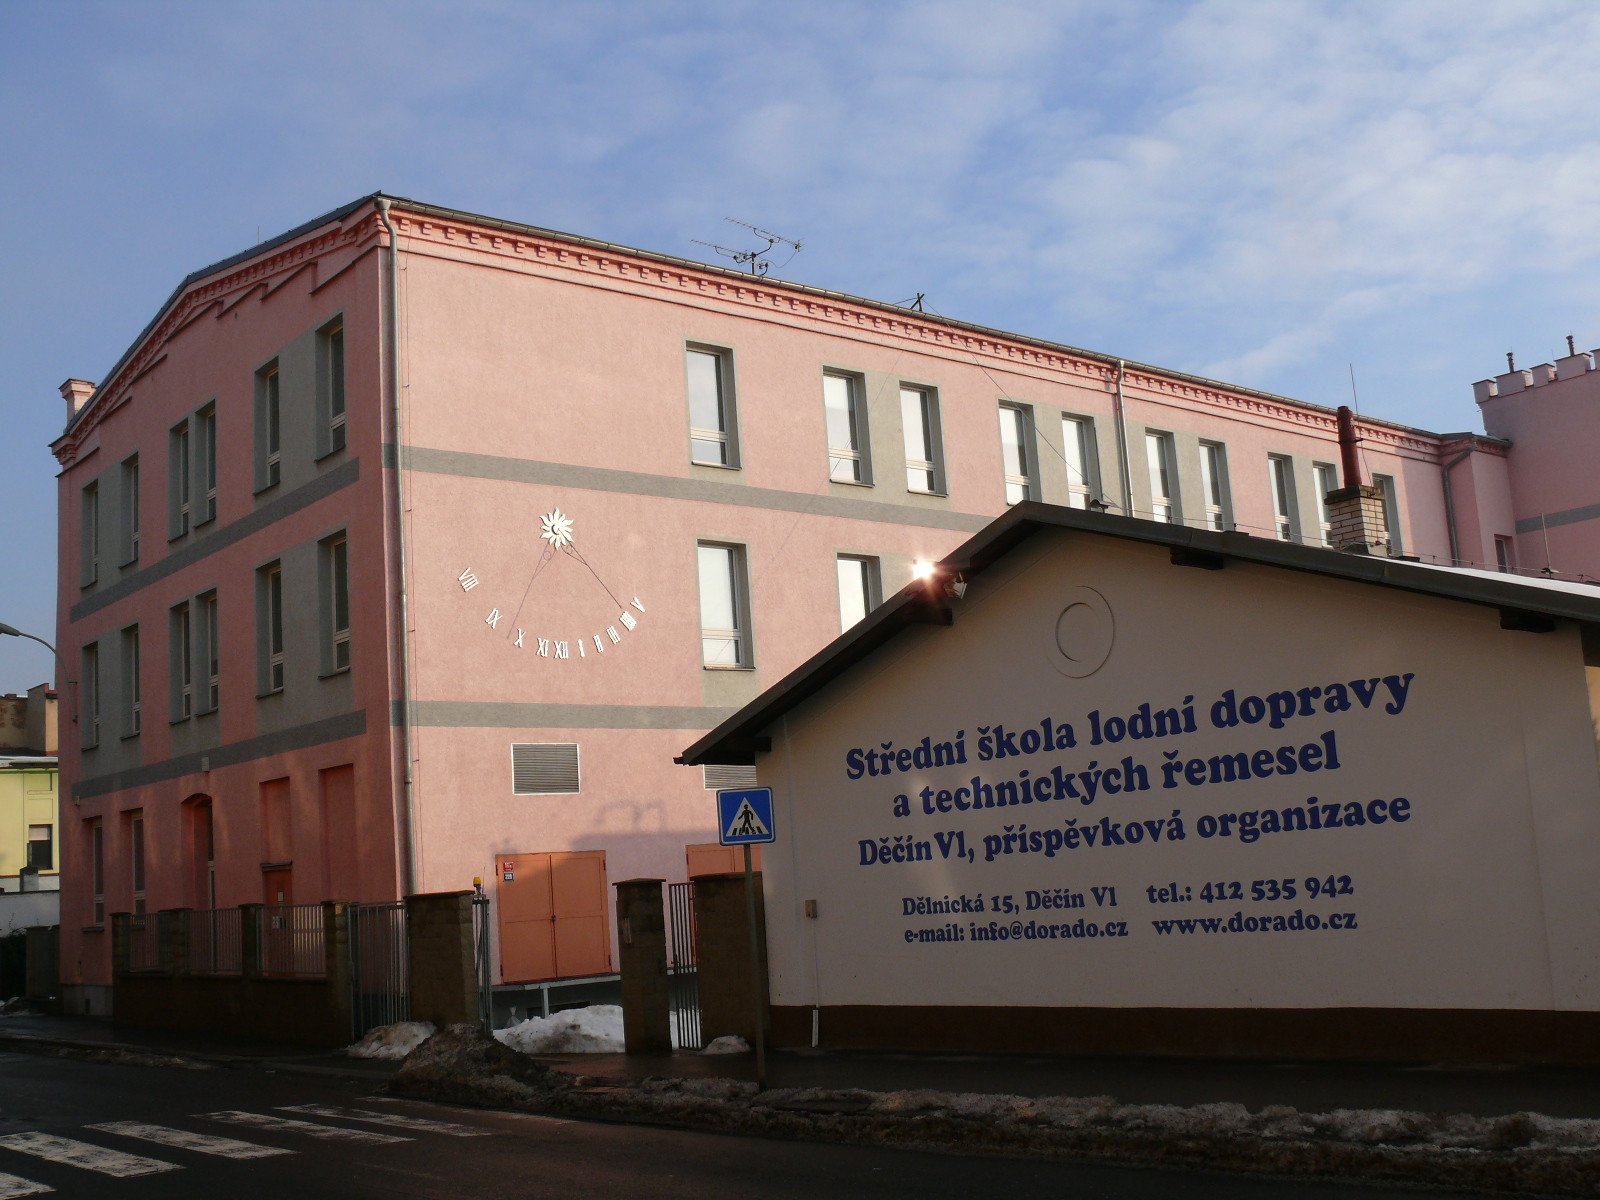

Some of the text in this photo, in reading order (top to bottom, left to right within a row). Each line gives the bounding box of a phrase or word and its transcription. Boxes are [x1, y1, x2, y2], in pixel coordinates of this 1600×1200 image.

[513, 628, 526, 648] X
[536, 637, 549, 657] XI
[846, 673, 1415, 781] Střední škola lodní dopravy
[893, 731, 1341, 817] a technických řemesel
[858, 834, 933, 866] Děčín
[984, 809, 1187, 861] příspěvková
[1197, 797, 1411, 843] organizace
[901, 893, 985, 915] Dělnická
[991, 895, 1020, 914] 15,
[1025, 889, 1086, 910] Děčín
[1148, 875, 1354, 905] tel.: 412 535 942
[904, 918, 1129, 943] e-mail: info@dorado.cz
[1152, 908, 1358, 936] www.dorado.cz
